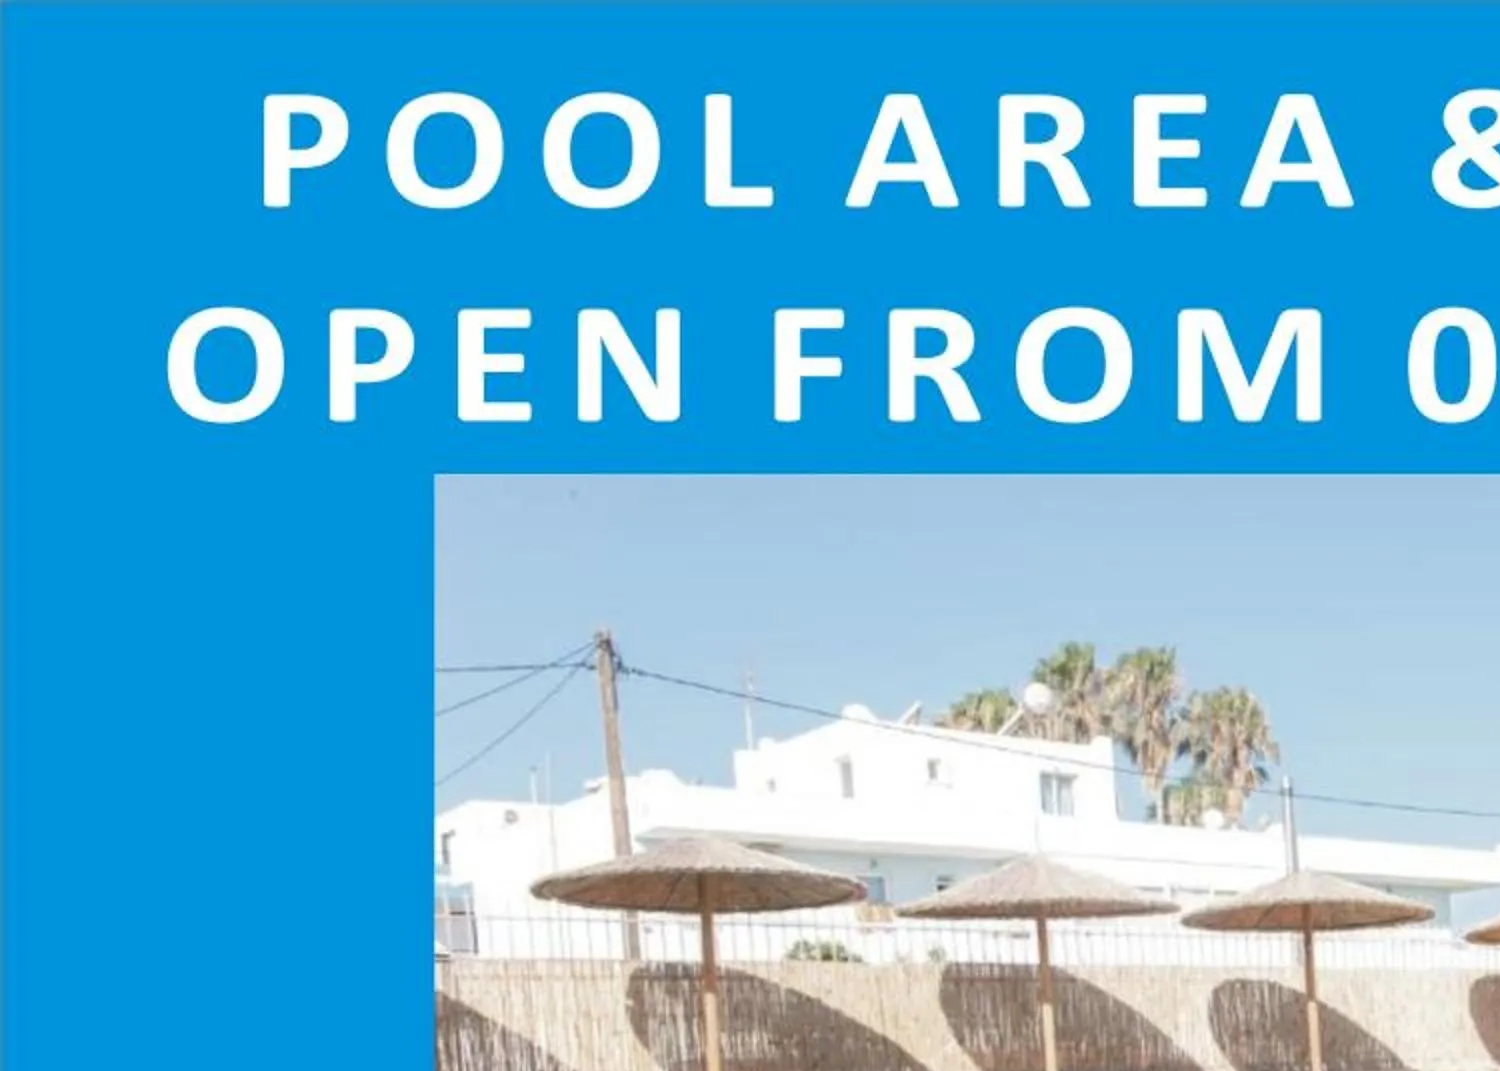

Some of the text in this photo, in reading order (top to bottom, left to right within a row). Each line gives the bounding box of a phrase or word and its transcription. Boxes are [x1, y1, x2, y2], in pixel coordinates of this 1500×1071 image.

[264, 92, 774, 208] POOL
[845, 94, 1354, 208] AREA
[168, 307, 681, 423] OPEN
[774, 307, 1322, 423] FROM
